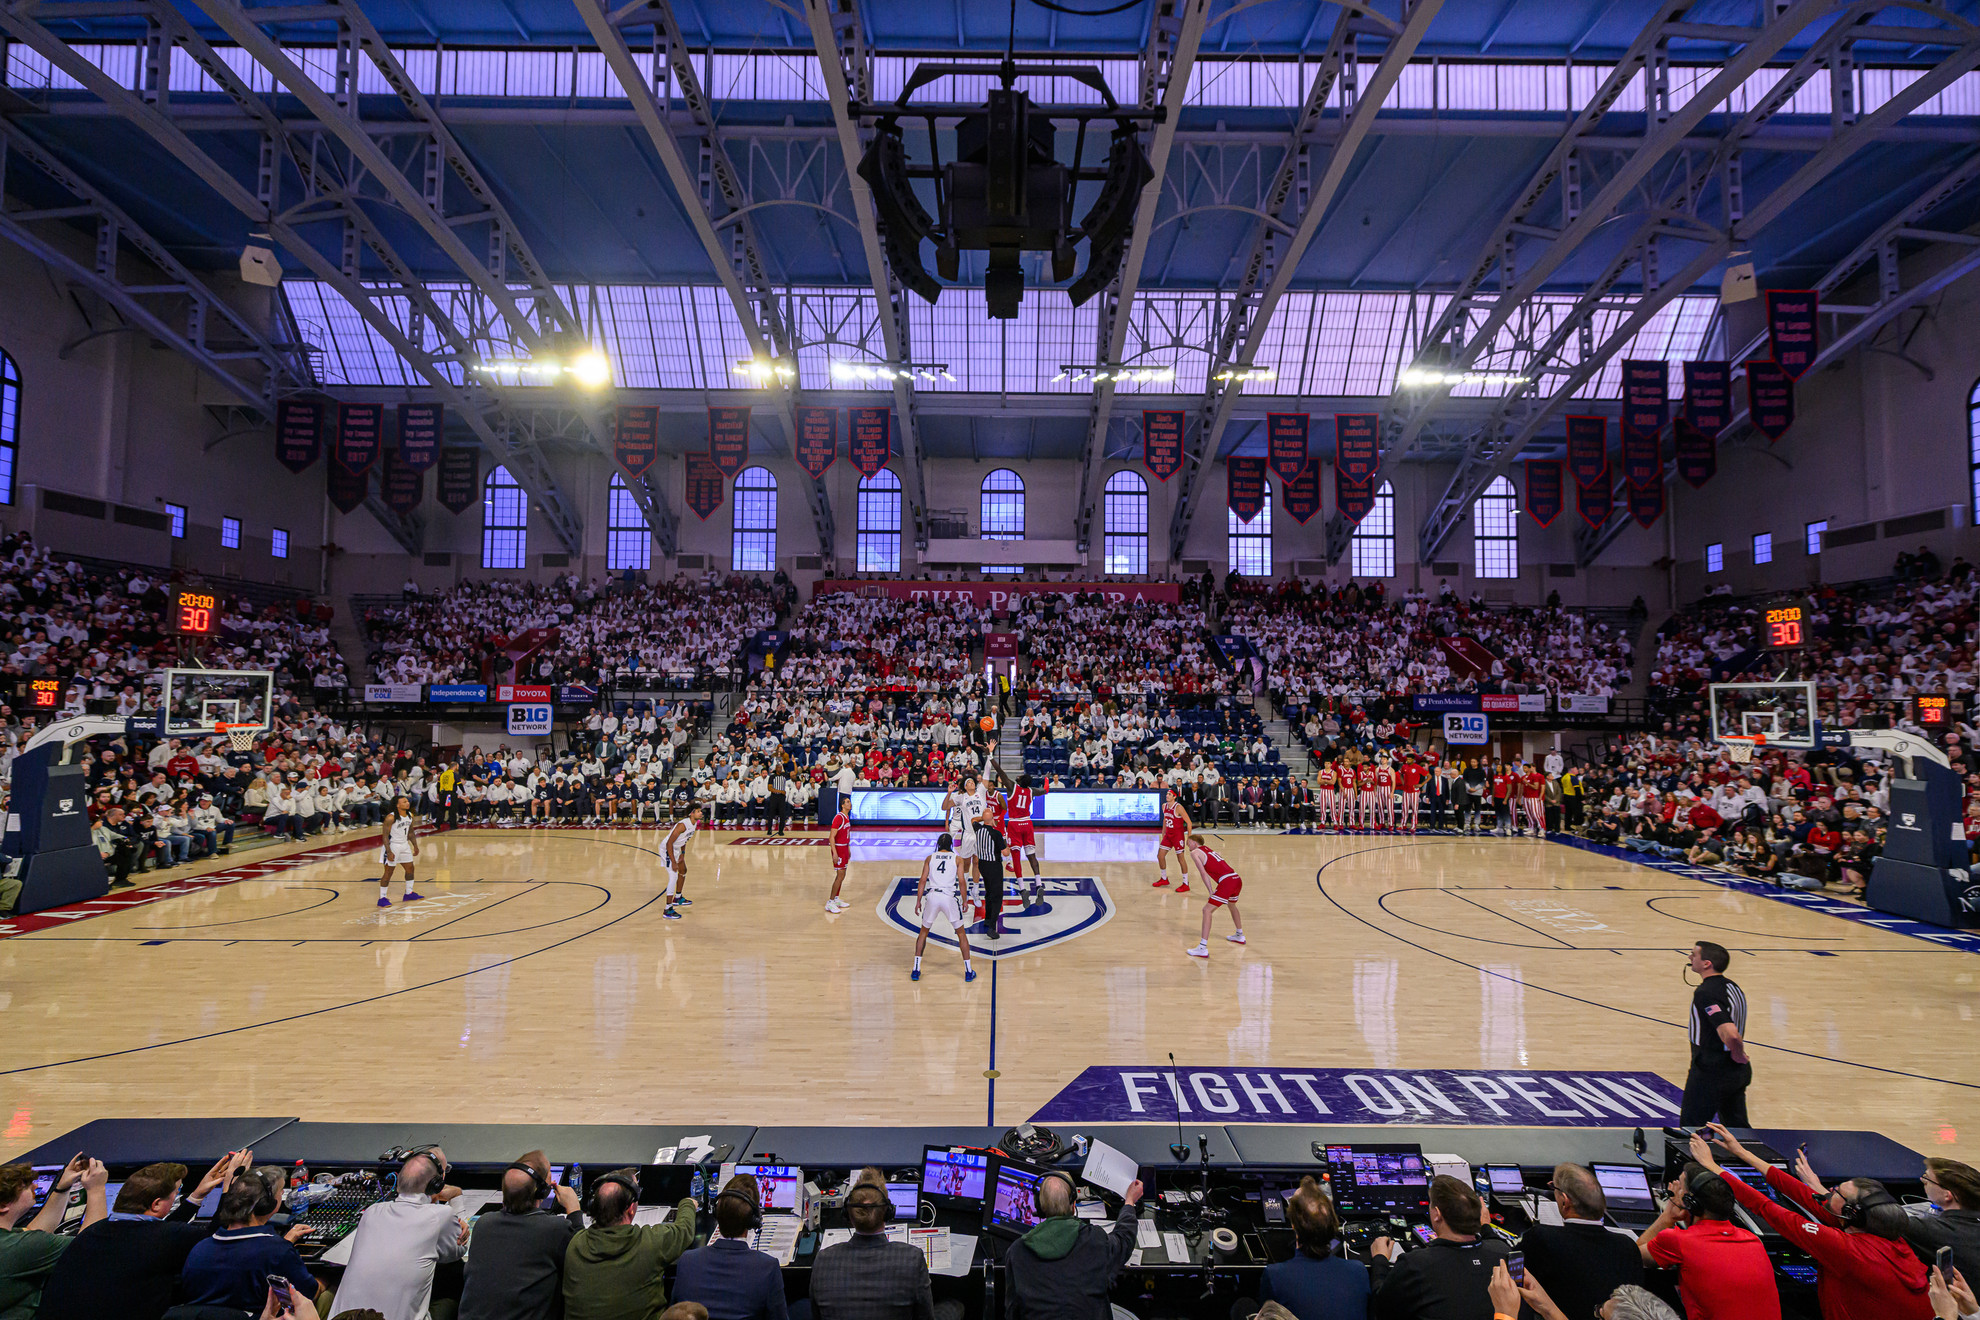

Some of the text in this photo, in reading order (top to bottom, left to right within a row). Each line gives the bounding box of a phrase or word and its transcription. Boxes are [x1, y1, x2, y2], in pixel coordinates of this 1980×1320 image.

[179, 592, 214, 609] 20:00
[181, 607, 209, 631] 30
[1766, 607, 1802, 623] 20:00
[1771, 621, 1800, 646] 30
[36, 691, 54, 706] 30
[1483, 701, 1518, 709] GO QUAKERS!
[1918, 697, 1946, 708] 20:00
[1923, 709, 1941, 722] 30
[1449, 732, 1483, 740] NETWORK
[1016, 794, 1027, 809] 11
[971, 806, 980, 814] 14
[1165, 818, 1174, 828] 32
[741, 839, 825, 847] FIGHT
[937, 860, 946, 874] 4
[1119, 1072, 1681, 1119] FIGHT ON PENN
